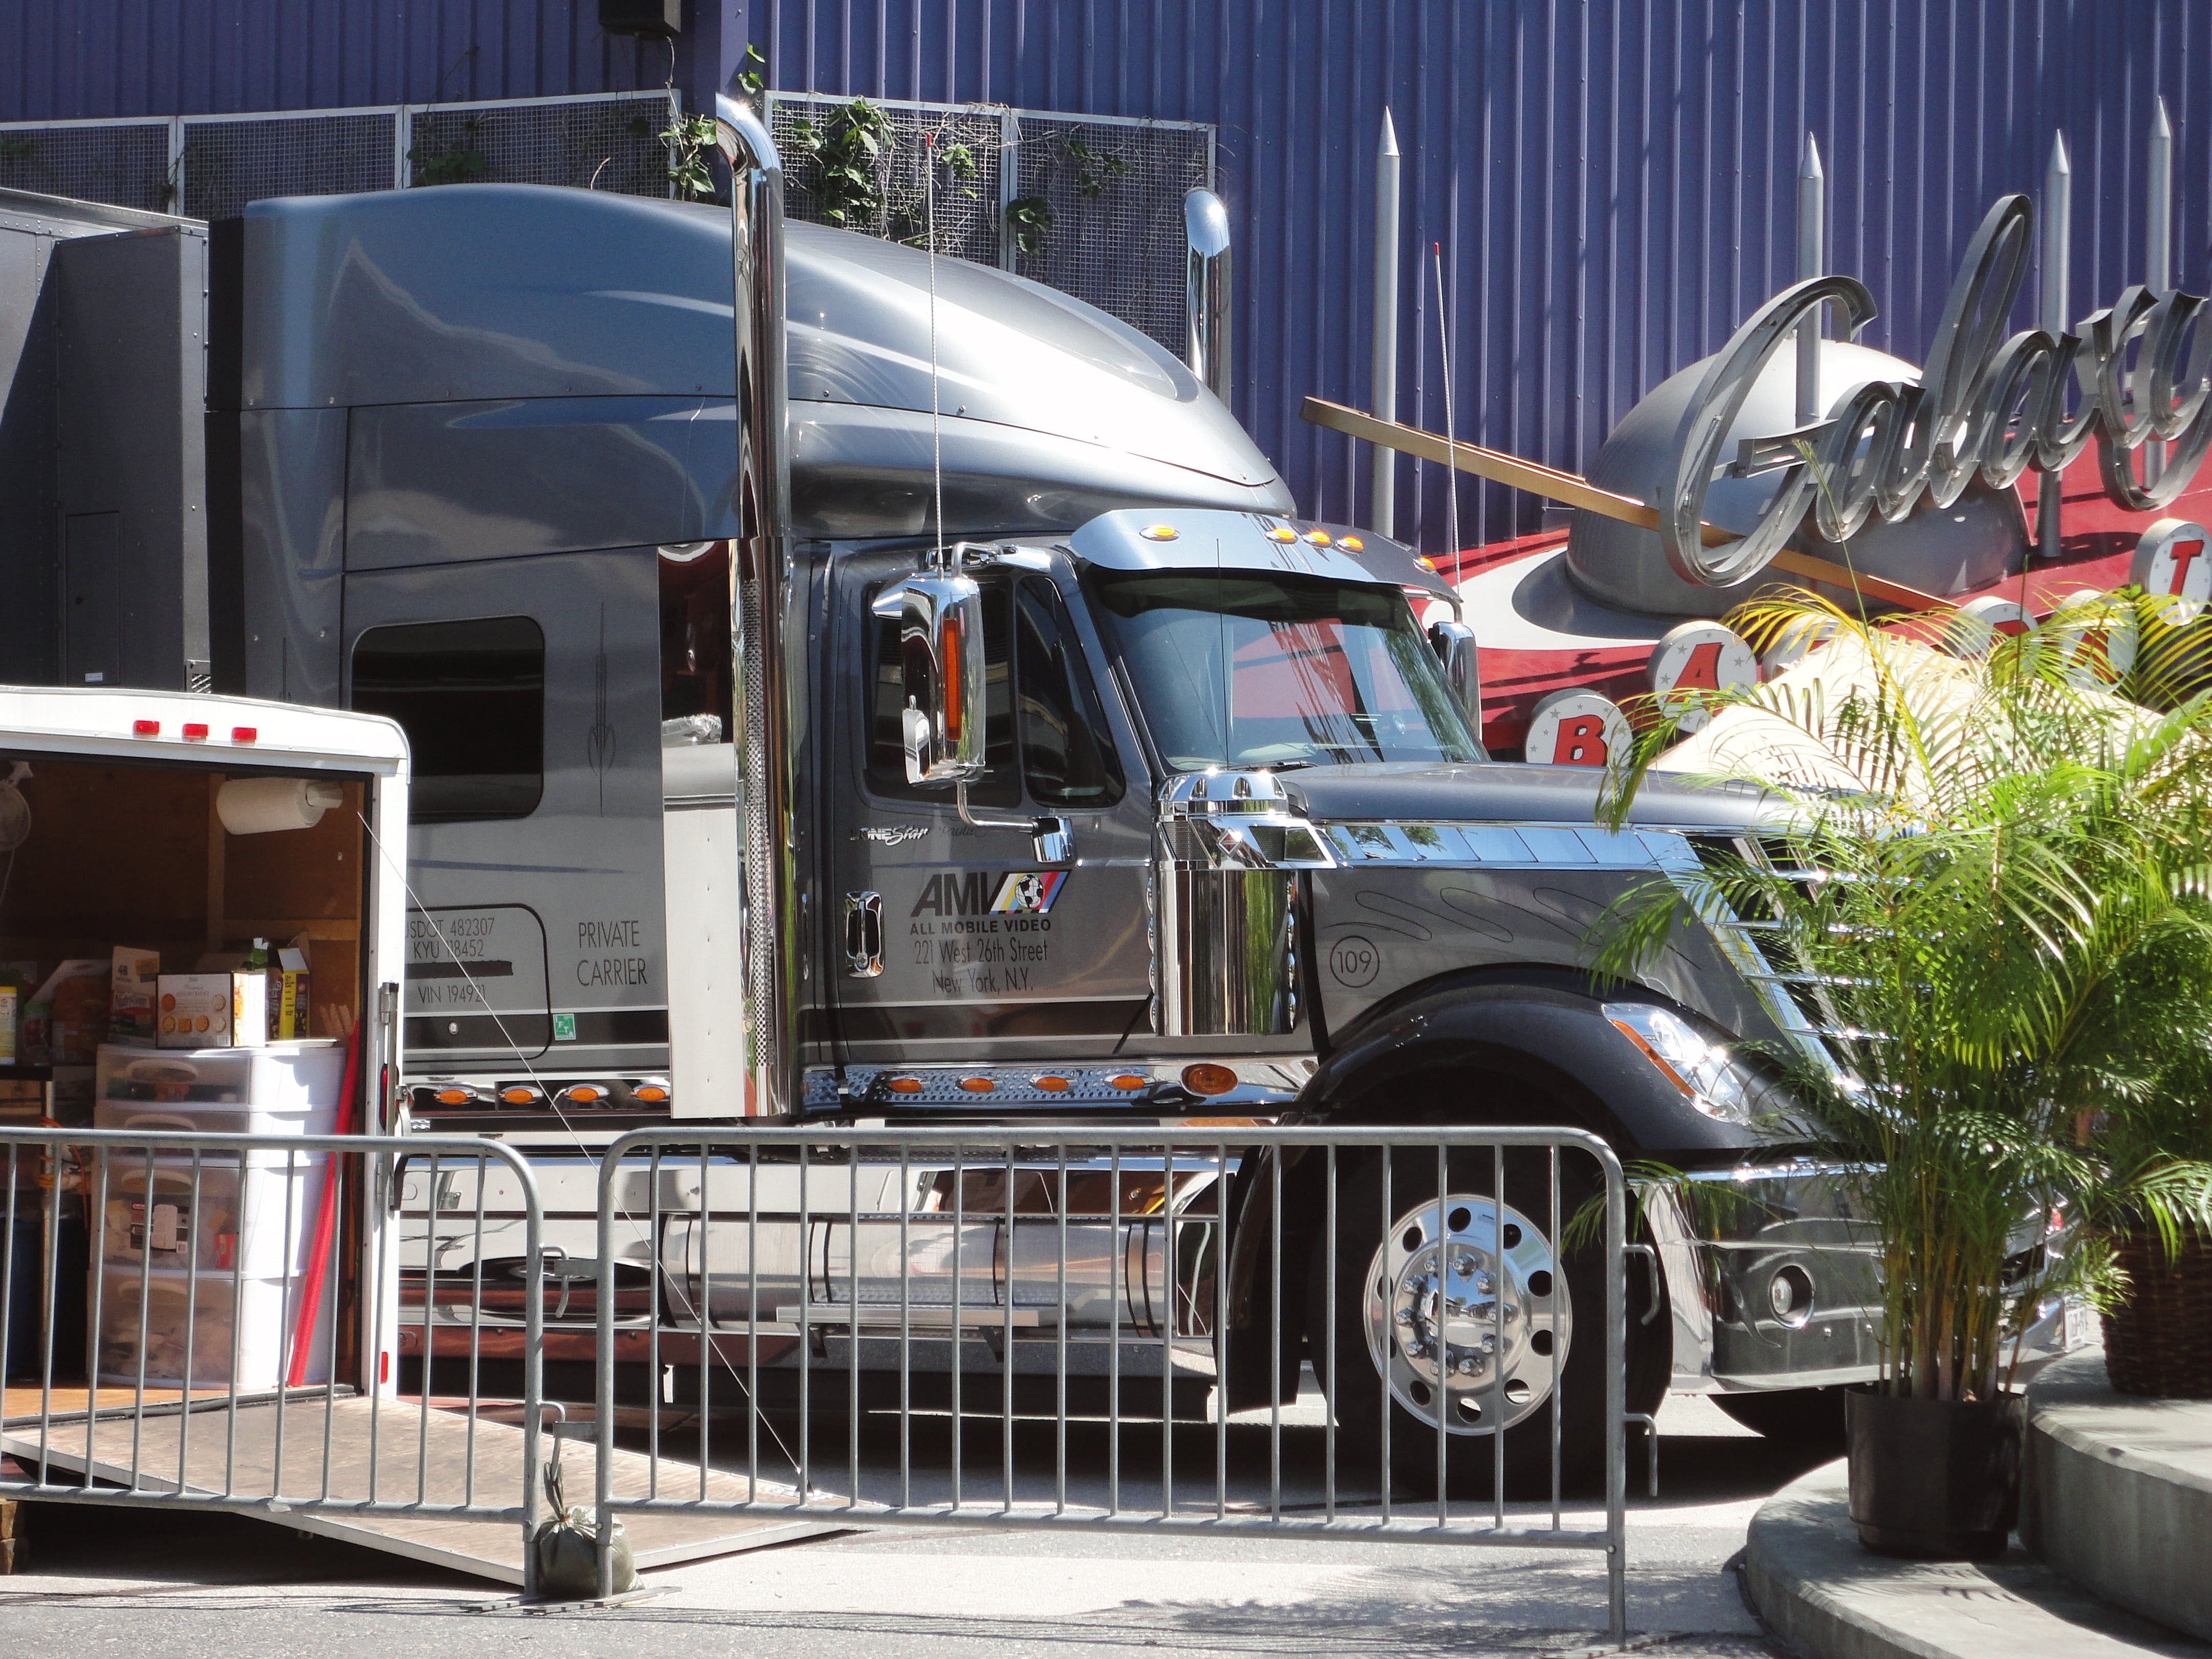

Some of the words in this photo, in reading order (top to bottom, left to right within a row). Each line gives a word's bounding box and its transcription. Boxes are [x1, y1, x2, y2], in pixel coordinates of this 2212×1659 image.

[909, 870, 1007, 918] AMV
[450, 918, 495, 937] 482307
[579, 920, 640, 948] PRIVATE
[910, 922, 935, 935] ALL
[941, 920, 998, 934] MOBILE
[1004, 919, 1051, 932] VIDEO
[413, 941, 440, 959] KYU
[914, 940, 934, 964] 221
[938, 939, 971, 964] West
[976, 937, 1005, 963] 26th
[1010, 936, 1048, 962] Street
[1337, 950, 1372, 974] 109
[577, 958, 648, 986] CARRIER
[932, 969, 962, 993] New
[967, 968, 1000, 995] York,
[1005, 967, 1033, 991] N.Y.
[418, 985, 442, 1004] VIN
[446, 984, 486, 1003] 194921
